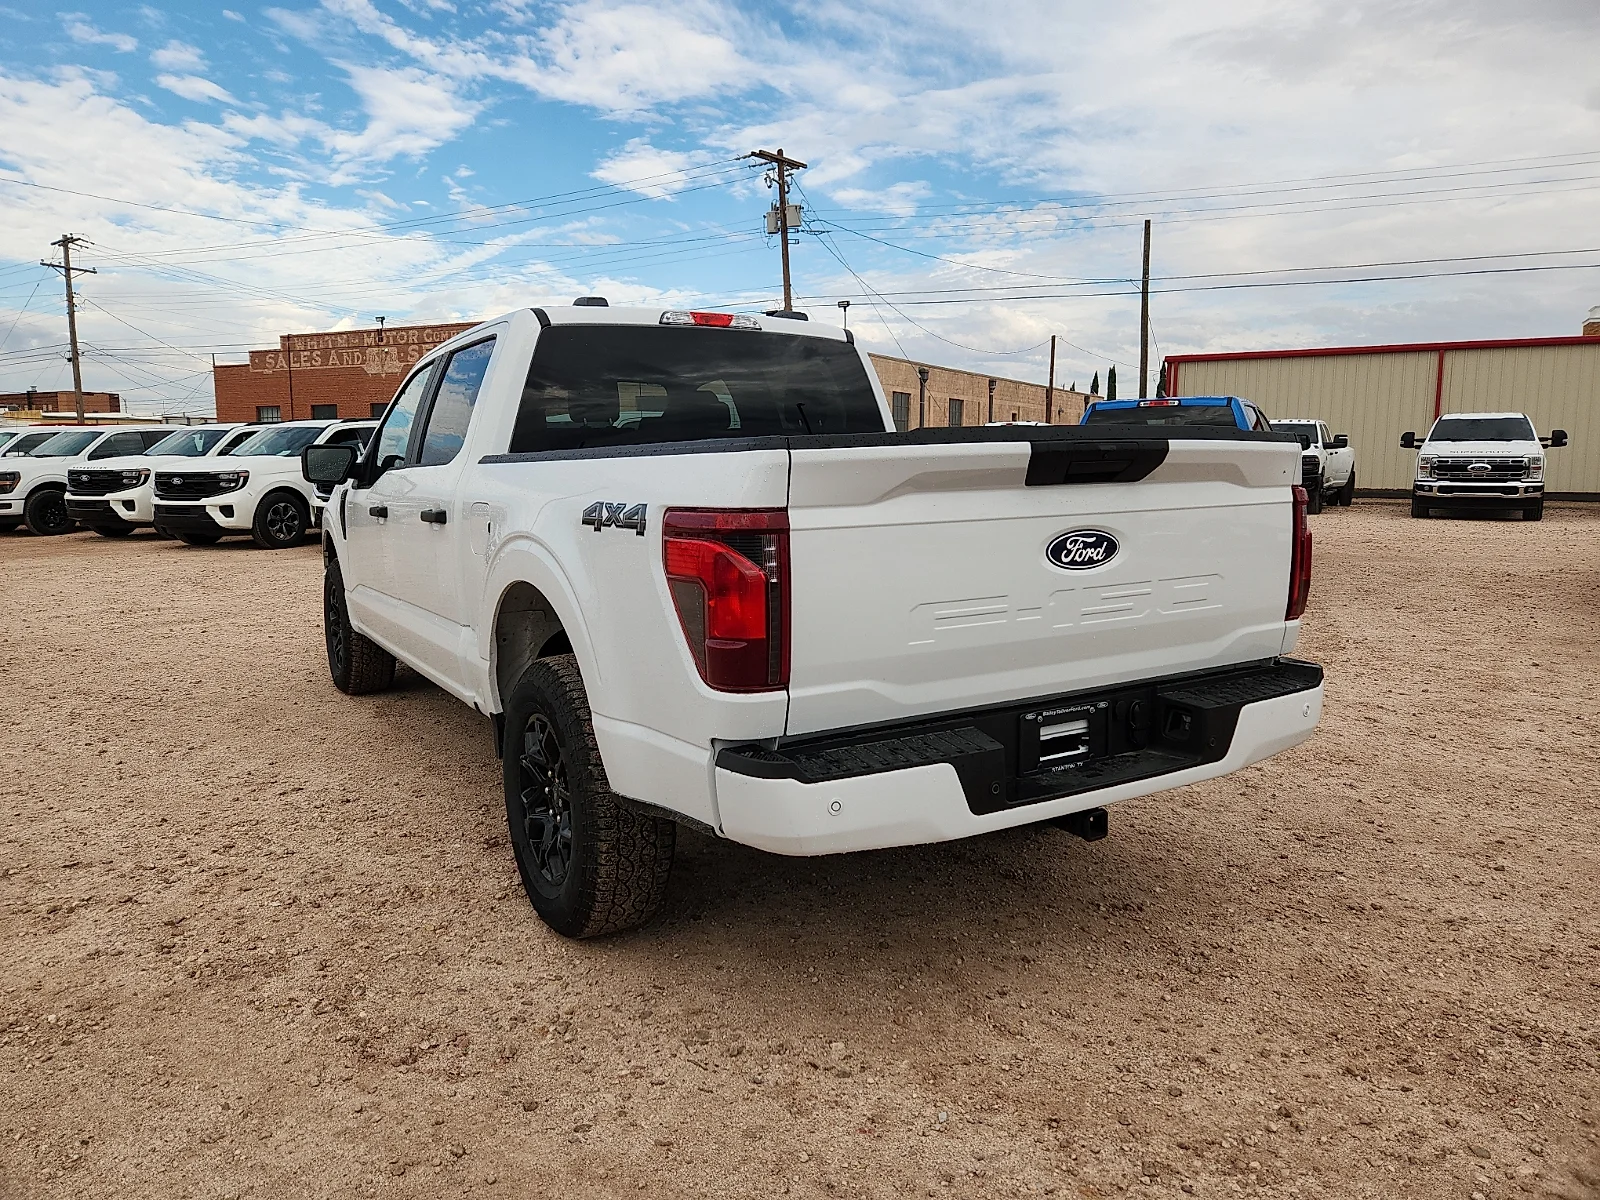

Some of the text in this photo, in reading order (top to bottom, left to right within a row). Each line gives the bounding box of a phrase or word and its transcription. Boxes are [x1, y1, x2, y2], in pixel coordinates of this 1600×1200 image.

[363, 329, 418, 346] MOTOR
[265, 351, 322, 368] SALES
[328, 350, 362, 366] AND
[1060, 535, 1108, 564] Ford
[907, 573, 1225, 645] F-150
